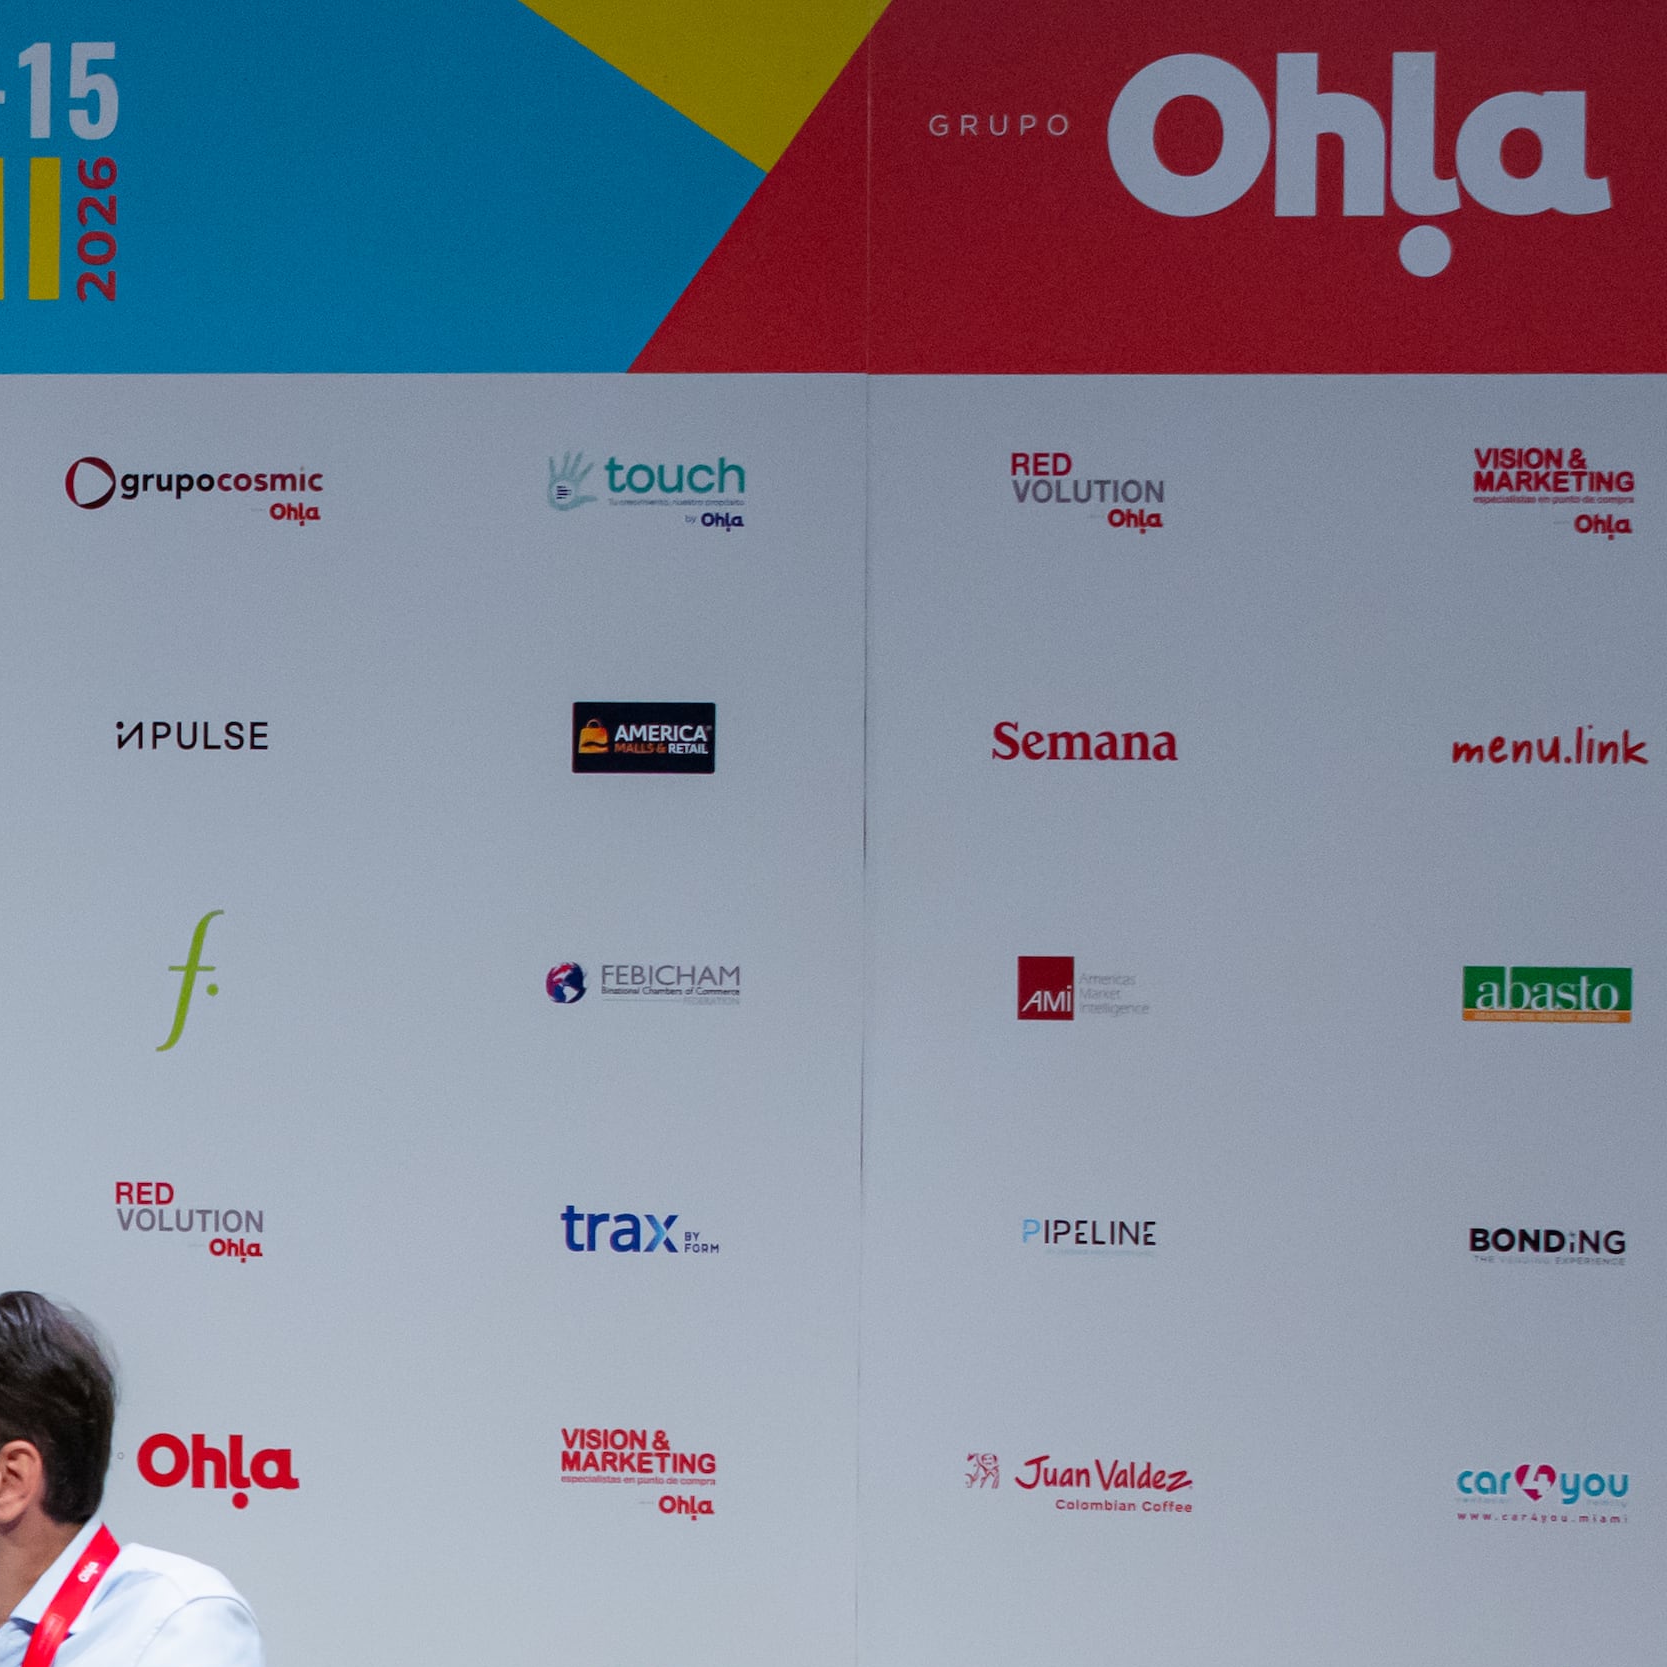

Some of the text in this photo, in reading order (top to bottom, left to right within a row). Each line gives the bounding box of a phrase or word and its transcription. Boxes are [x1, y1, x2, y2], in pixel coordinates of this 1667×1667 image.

[928, 51, 1612, 278] GRUPO Ohla
[76, 157, 117, 302] 2026
[1011, 452, 1072, 476] RED
[1474, 447, 1587, 470] VISION &
[121, 468, 323, 500] grupocosmic
[604, 457, 746, 494] touch
[1474, 470, 1635, 493] MARKETING
[1013, 479, 1164, 504] VOLUTION
[269, 502, 321, 526] Ohla
[701, 512, 744, 532] Ohla
[1107, 508, 1163, 534] Ohla
[1574, 514, 1633, 540] Ohla
[614, 724, 707, 742] AMERICA
[992, 721, 1178, 761] Semana
[1452, 725, 1648, 765] menu.link
[614, 742, 708, 754] MALLS & RETAIL
[601, 964, 740, 987] FEBICHAM
[1476, 967, 1620, 1011] abasto
[116, 1181, 174, 1205] RED
[117, 1208, 263, 1233] VOLUTION
[560, 1205, 678, 1253] trax
[1023, 1218, 1156, 1247] PIPELINE
[209, 1238, 263, 1263] Ohla
[561, 1428, 670, 1452] VISION &
[137, 1433, 300, 1509] Ohla
[561, 1451, 716, 1474] MARKETING
[1015, 1455, 1193, 1493] Juan Valdez
[658, 1495, 715, 1521] Ohla
